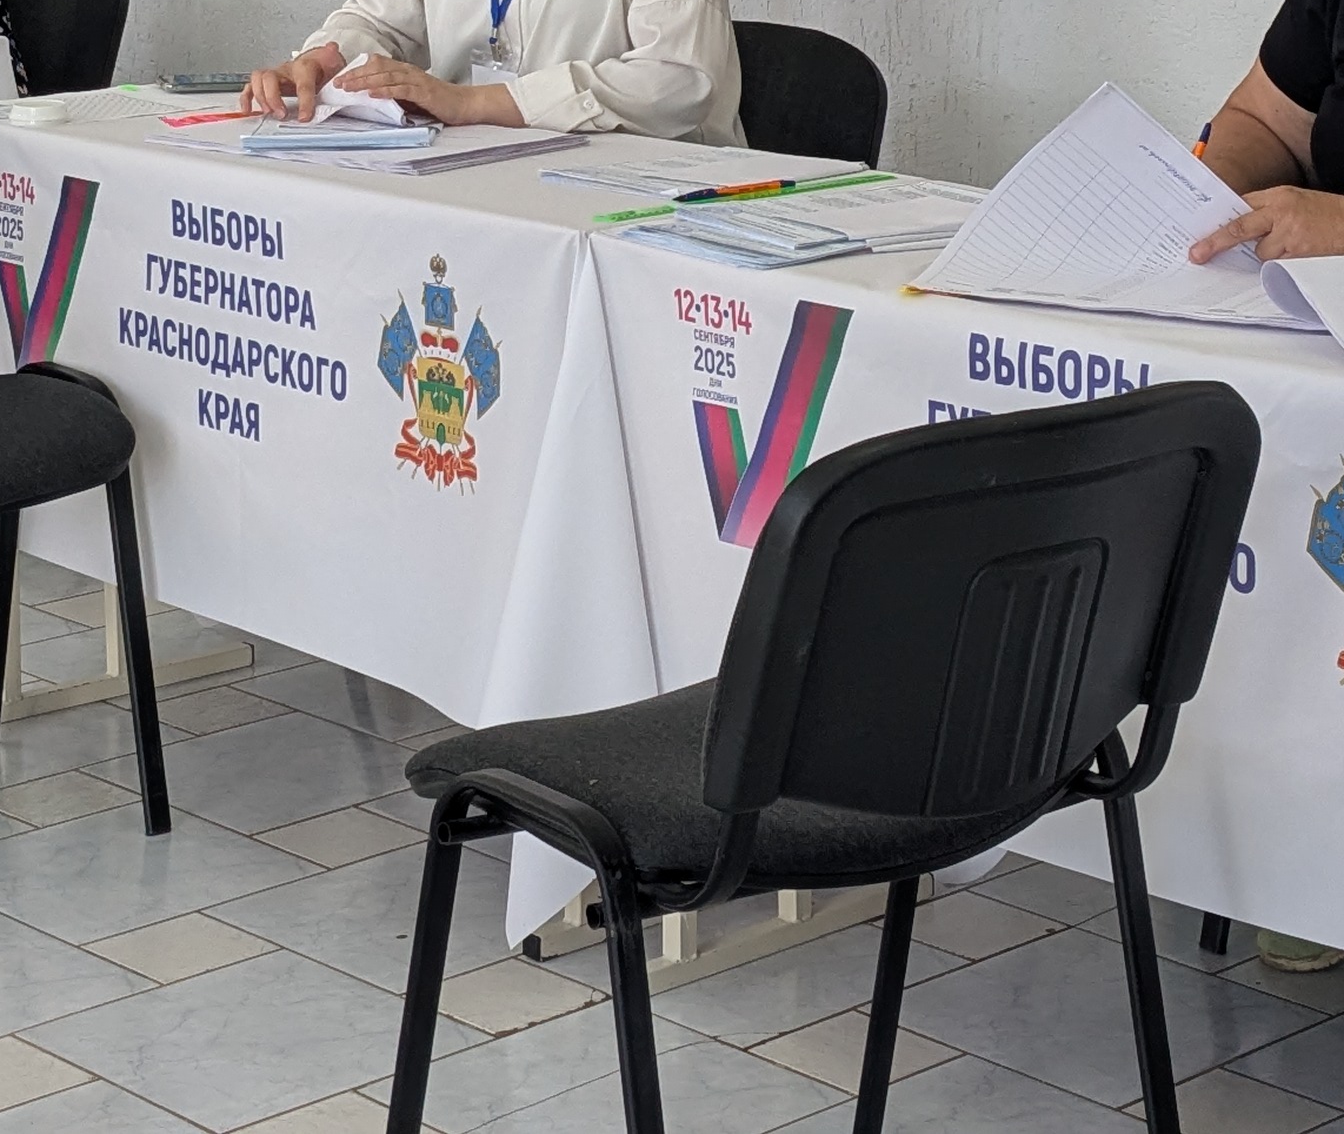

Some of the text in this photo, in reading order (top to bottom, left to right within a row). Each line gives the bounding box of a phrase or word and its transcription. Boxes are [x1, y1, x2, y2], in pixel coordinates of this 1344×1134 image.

[171, 198, 284, 261] ВЫБОРЫ
[145, 253, 317, 331] ГУБЕРНАТОРА
[119, 307, 348, 403] КРАСНОДАРСКОГО
[694, 345, 736, 379] 2025
[198, 388, 260, 443] КРАЯ
